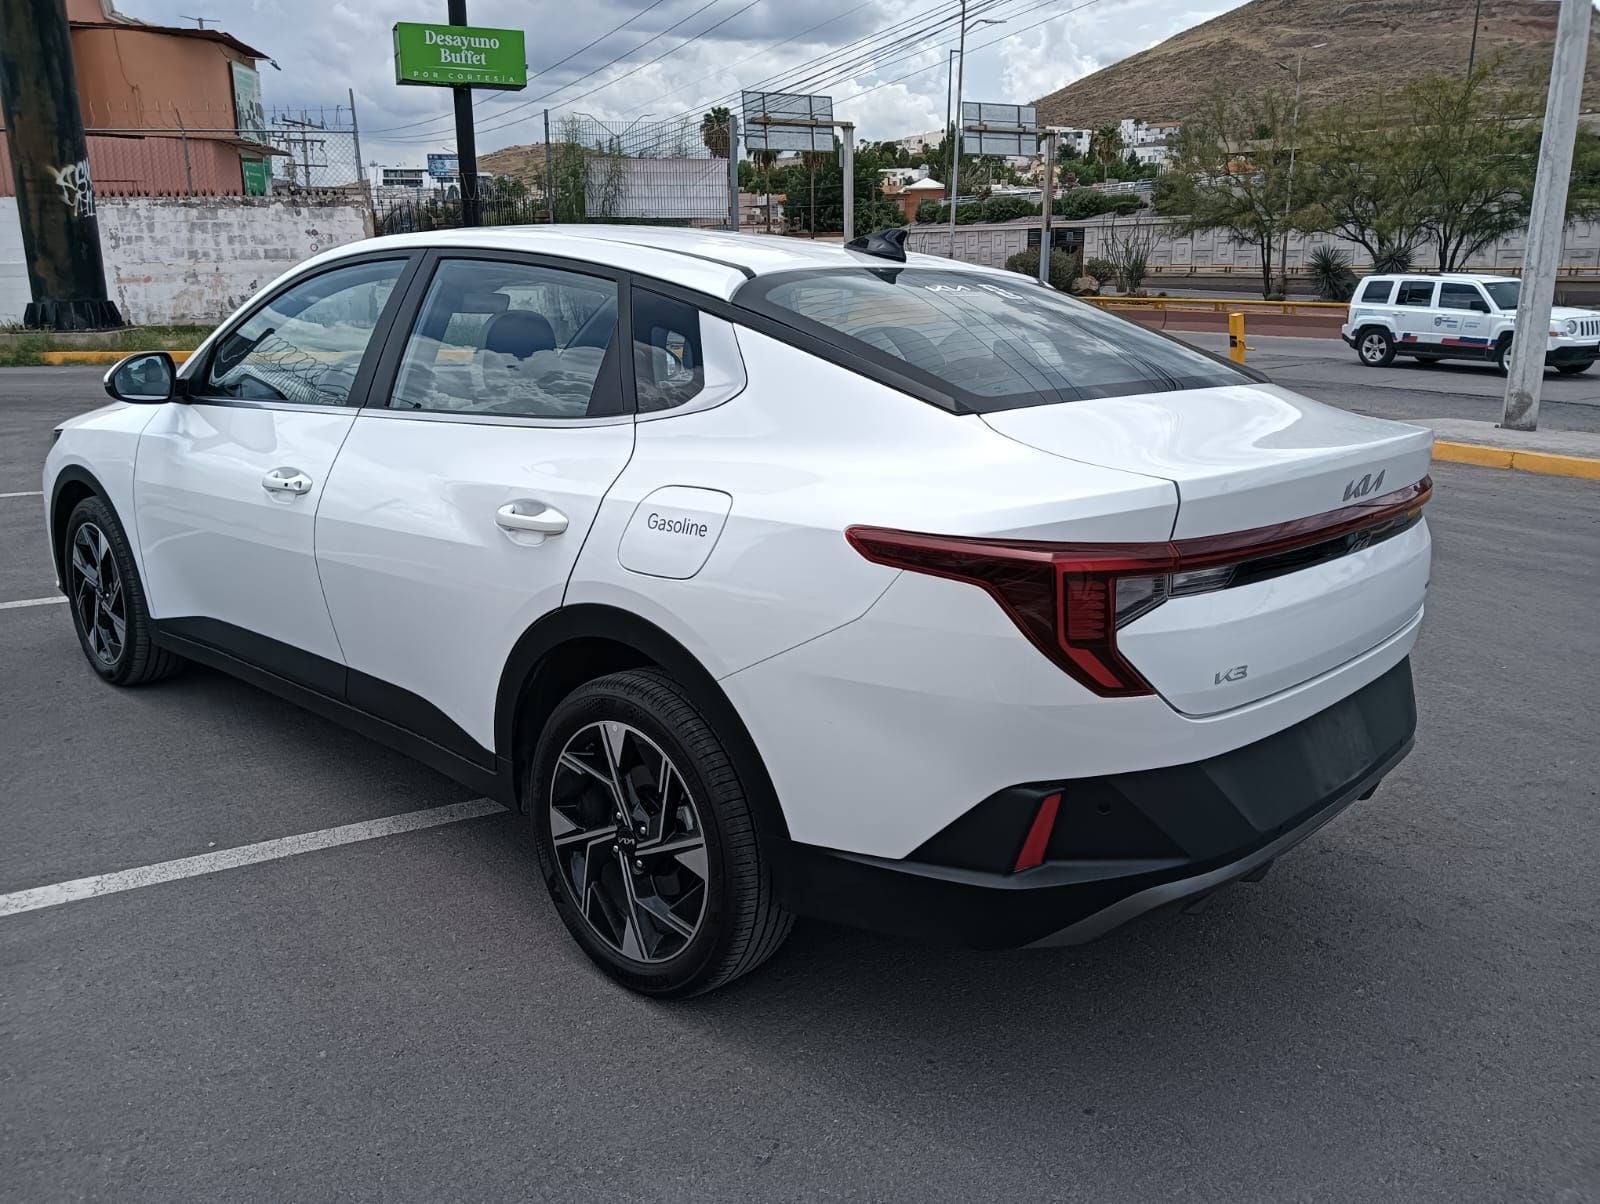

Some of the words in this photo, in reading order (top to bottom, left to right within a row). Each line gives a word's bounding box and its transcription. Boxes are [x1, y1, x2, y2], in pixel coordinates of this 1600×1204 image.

[424, 30, 500, 49] Desayuno
[440, 48, 487, 65] Buffet
[413, 70, 438, 78] POR
[647, 513, 708, 537] Gasoline
[1214, 665, 1248, 685] K3
